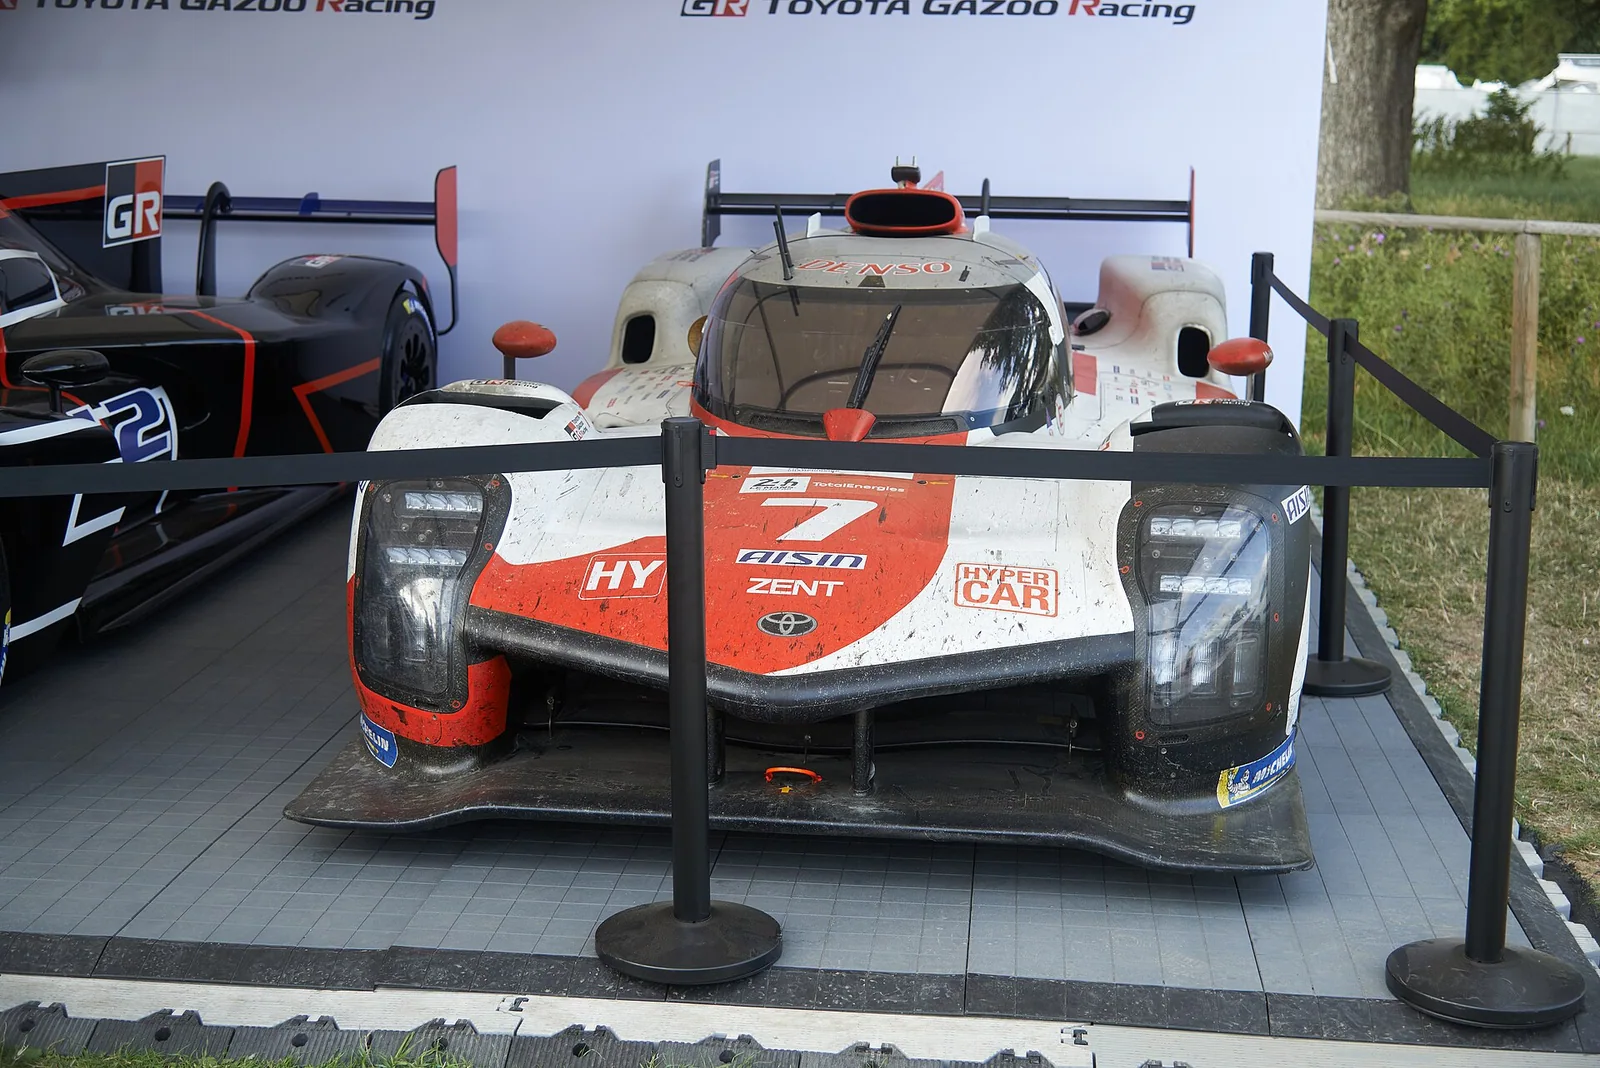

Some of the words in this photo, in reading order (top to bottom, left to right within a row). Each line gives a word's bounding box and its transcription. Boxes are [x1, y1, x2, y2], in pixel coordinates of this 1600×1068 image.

[316, 0, 436, 20] Racing
[768, 0, 911, 15] TOYOTA
[922, 0, 1059, 16] GAZOO
[1068, 0, 1196, 25] Racing
[106, 190, 161, 239] GR
[795, 258, 953, 277] DENSO
[813, 480, 905, 493] TotalEnergies
[760, 497, 879, 541] 7
[738, 550, 863, 568] AISIN
[585, 560, 665, 591] HY
[963, 566, 1050, 586] HYPER
[746, 577, 845, 597] ZENT
[962, 580, 1050, 611] CAR
